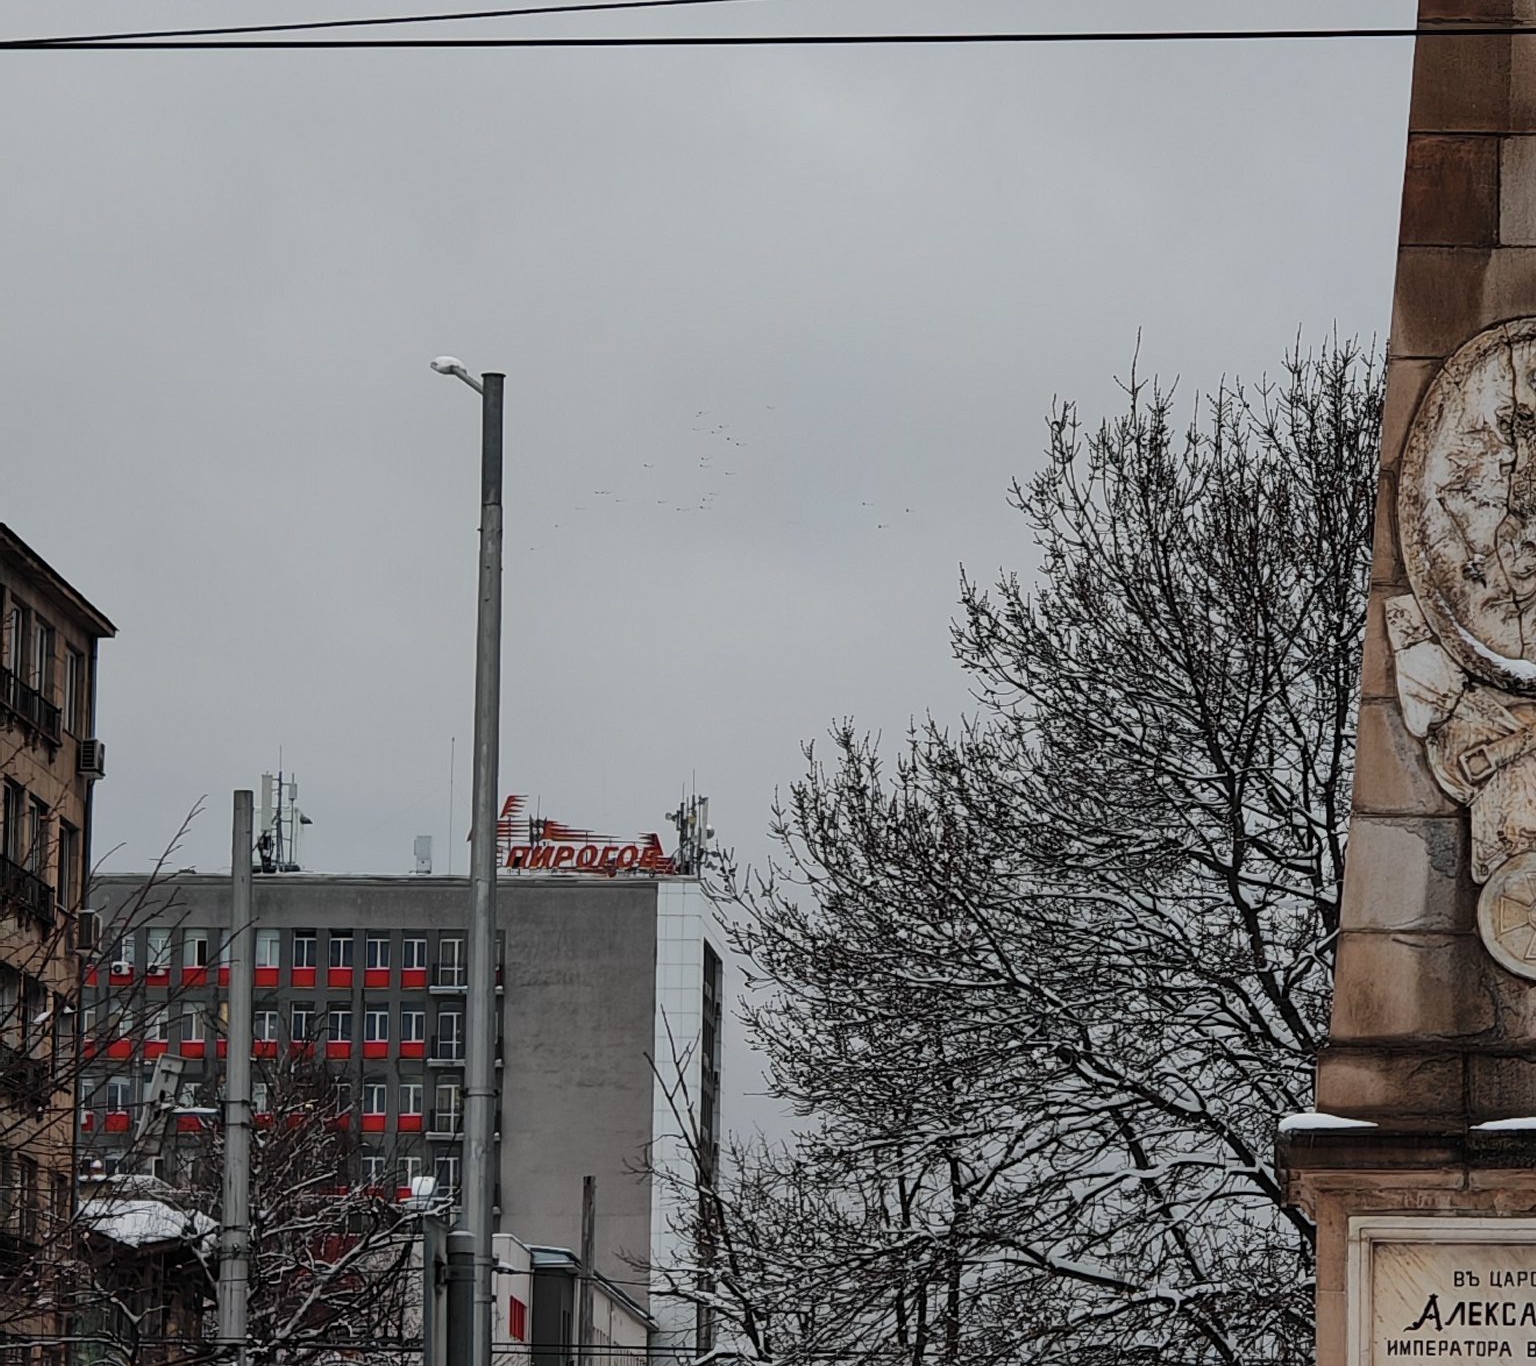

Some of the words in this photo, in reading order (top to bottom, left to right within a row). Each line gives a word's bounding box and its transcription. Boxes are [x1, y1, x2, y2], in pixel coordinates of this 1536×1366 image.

[506, 844, 658, 869] ПИРОГОВ
[1453, 1270, 1480, 1287] ВЪ
[1387, 1339, 1512, 1357] ИМПЕРАТОРА
